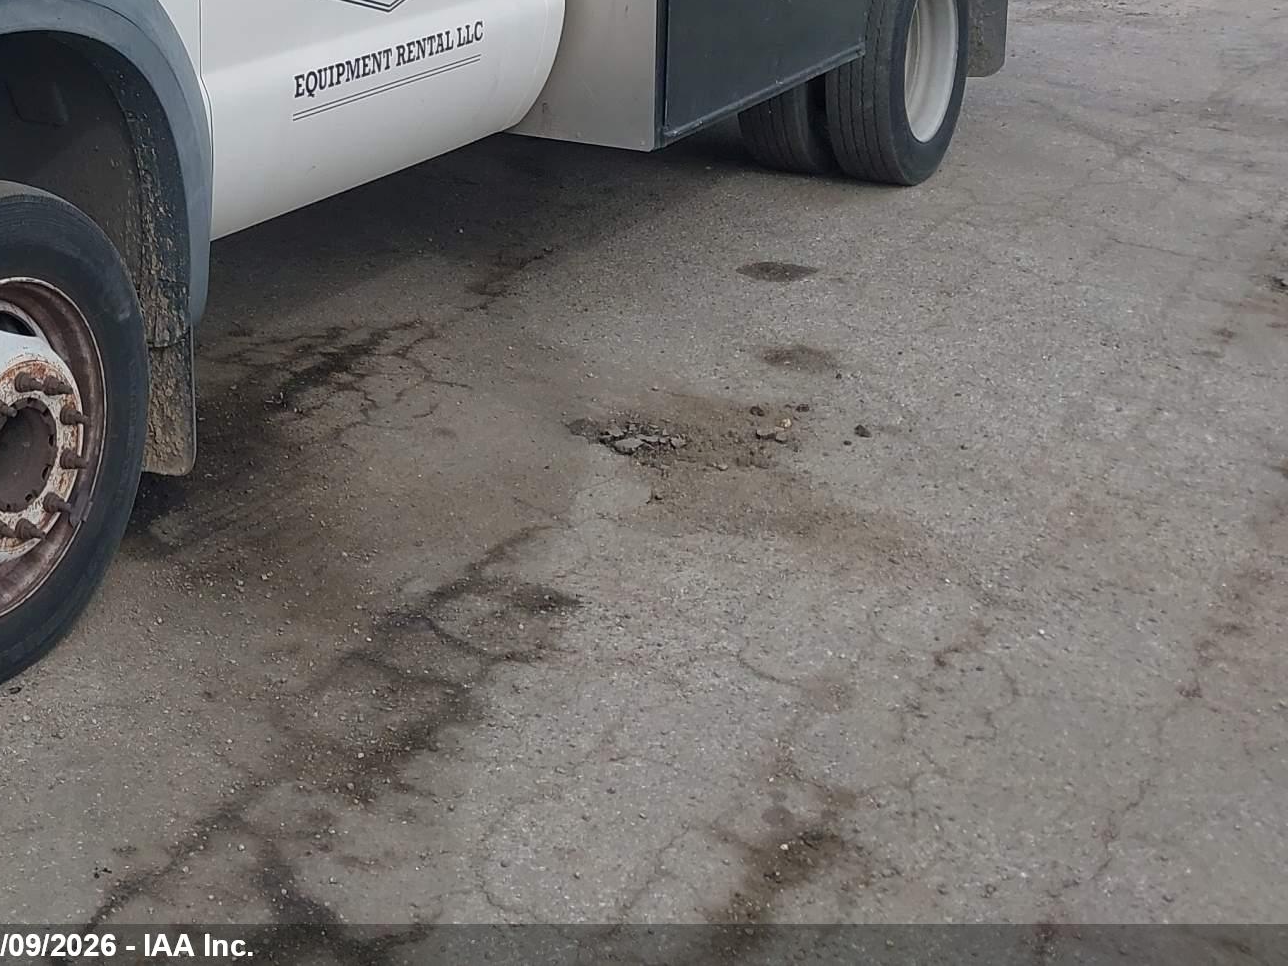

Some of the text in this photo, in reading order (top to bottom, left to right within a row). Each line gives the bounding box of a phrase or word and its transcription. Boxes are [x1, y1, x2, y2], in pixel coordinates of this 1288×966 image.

[293, 20, 485, 99] EQUIPMENT RENTAL LLC
